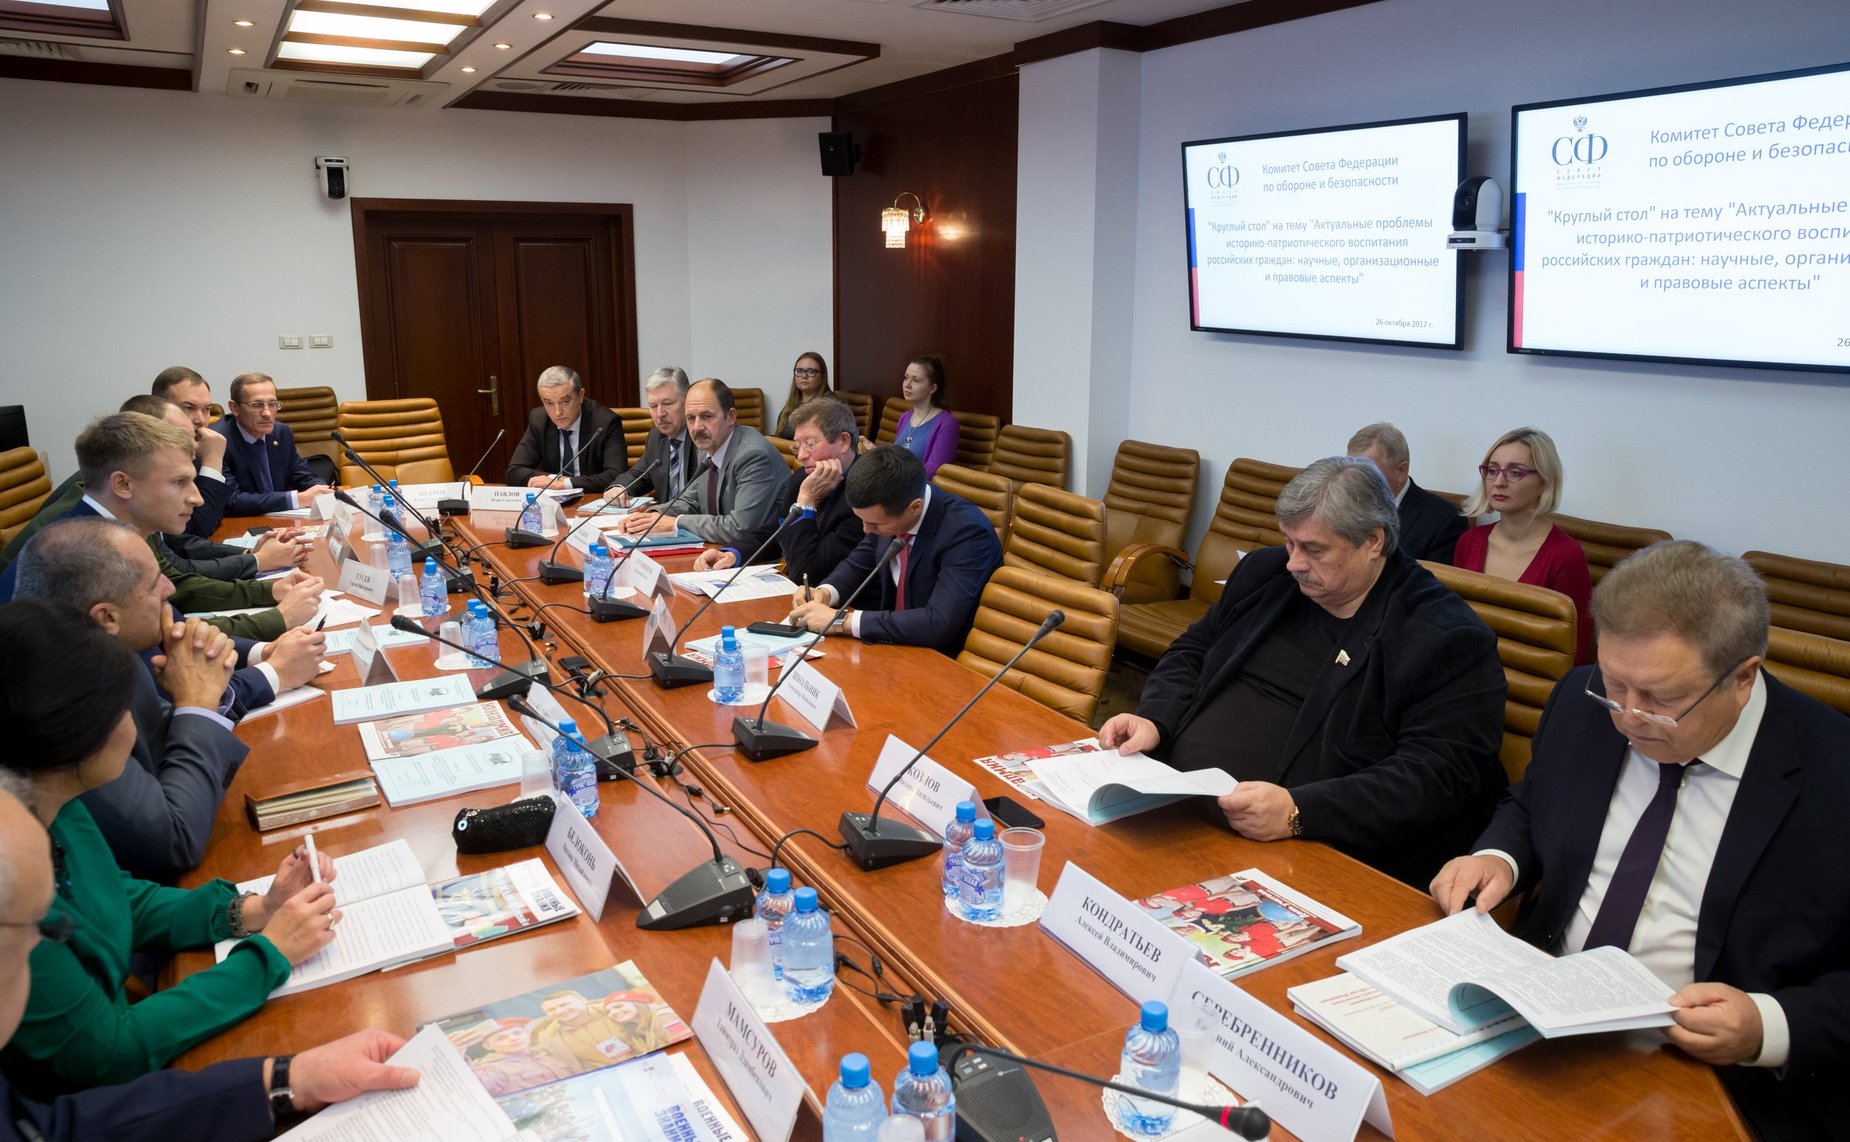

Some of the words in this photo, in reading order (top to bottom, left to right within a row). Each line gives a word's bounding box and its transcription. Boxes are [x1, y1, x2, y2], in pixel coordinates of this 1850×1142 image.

[1650, 127, 1720, 145] Комитет
[1725, 120, 1786, 138] Совета
[1552, 134, 1608, 166] СФ
[1649, 154, 1668, 168] по
[1673, 148, 1747, 167] обороне
[1752, 149, 1763, 161] и
[1768, 141, 1850, 160] безопас
[1262, 163, 1300, 175] Комитет
[1302, 160, 1336, 172] Совета
[1338, 156, 1399, 171] Федерации
[1207, 165, 1240, 189] СФ
[1263, 182, 1275, 193] по
[1276, 179, 1316, 193] обороне
[1319, 180, 1326, 190] и
[1328, 175, 1399, 190] безопасности
[1548, 208, 1612, 226] "Круглый
[1616, 206, 1656, 222] стол"
[1660, 209, 1679, 220] на
[1684, 208, 1724, 222] тему
[1728, 201, 1848, 219] "Актуальные
[1208, 220, 1246, 234] "Круглый
[1248, 219, 1270, 232] стол"
[1272, 221, 1283, 231] на
[1285, 221, 1307, 233] тему
[1309, 218, 1373, 234] "Актуальные
[1375, 216, 1433, 232] проблемы
[1226, 237, 1346, 252] историко-патриотического
[1348, 236, 1409, 250] воспитания
[1576, 229, 1792, 247] историко-патриотического
[1207, 254, 1253, 268] российских
[1255, 255, 1296, 268] граждан:
[1297, 255, 1341, 269] научные,
[1343, 255, 1440, 270] организационные
[1541, 253, 1621, 269] российских
[1625, 254, 1696, 270] граждан:
[1700, 254, 1779, 270] научные,
[1265, 273, 1271, 282] и
[1272, 273, 1317, 286] правовые
[1319, 272, 1364, 285] аспекты"
[1640, 278, 1650, 289] и
[1653, 278, 1733, 293] правовые
[1738, 274, 1821, 290] аспекты"
[1375, 318, 1384, 327] 26
[1385, 319, 1411, 329] октября
[1412, 319, 1427, 328] 2017
[567, 826, 596, 871] БЕЛОКОНЬ
[1081, 896, 1162, 963] КОНДРАТЬЕВ
[1075, 916, 1104, 941] Алексей
[1103, 936, 1157, 982] Владимирович
[725, 1001, 777, 1078] МАМСУРОВ
[1235, 1048, 1314, 1109] Александрович
